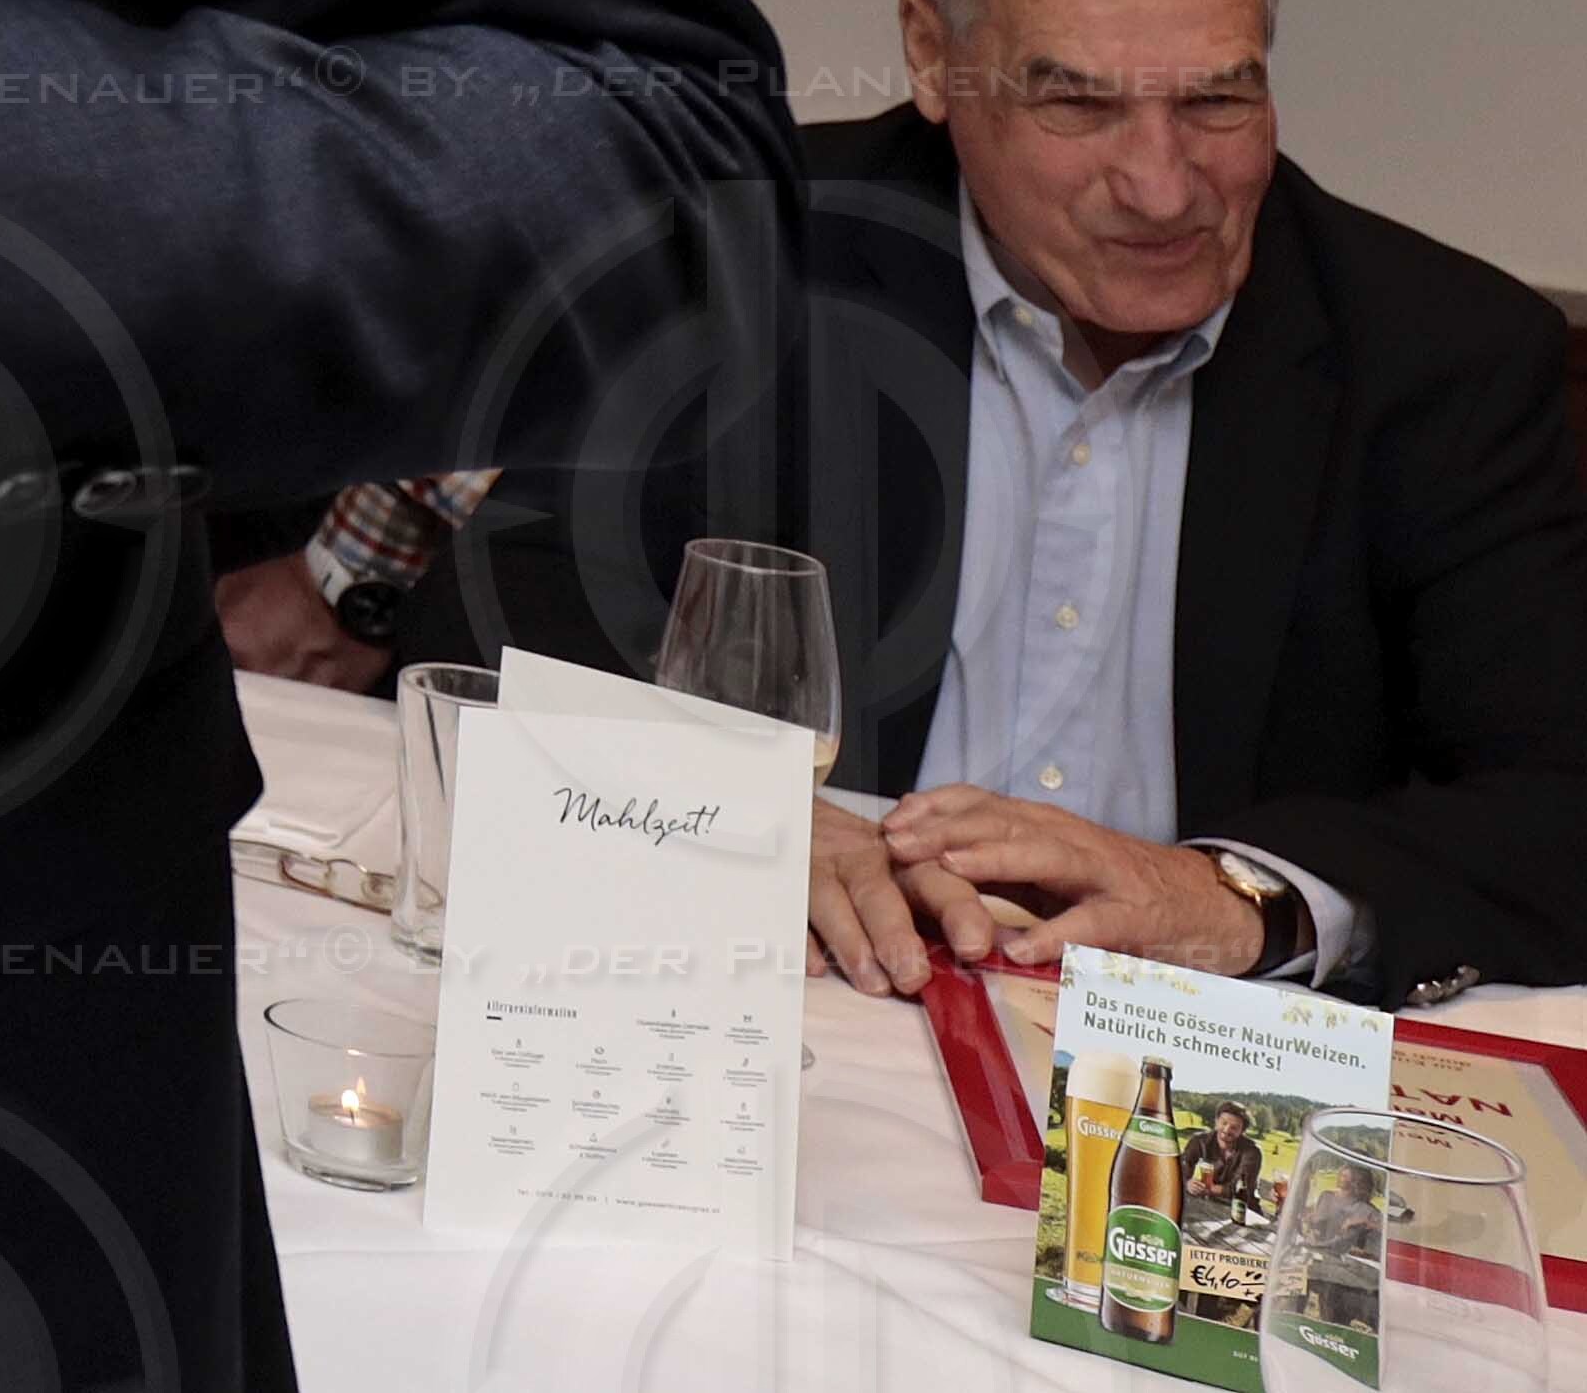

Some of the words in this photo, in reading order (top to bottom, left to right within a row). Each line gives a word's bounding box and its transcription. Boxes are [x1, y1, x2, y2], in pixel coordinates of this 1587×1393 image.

[554, 786, 720, 848] Mahlzeit!
[1083, 1012, 1167, 1045] Natürlich
[1171, 1034, 1283, 1072] schmeckt's!
[1085, 991, 1118, 1011] Das
[1124, 1000, 1168, 1023] neue
[1173, 1006, 1237, 1038] Gösser
[1241, 1026, 1367, 1070] NaturWeizen.
[1108, 1226, 1178, 1268] Gösser
[1190, 1249, 1216, 1263] JETZT
[1219, 1253, 1270, 1270] PROBIERE
